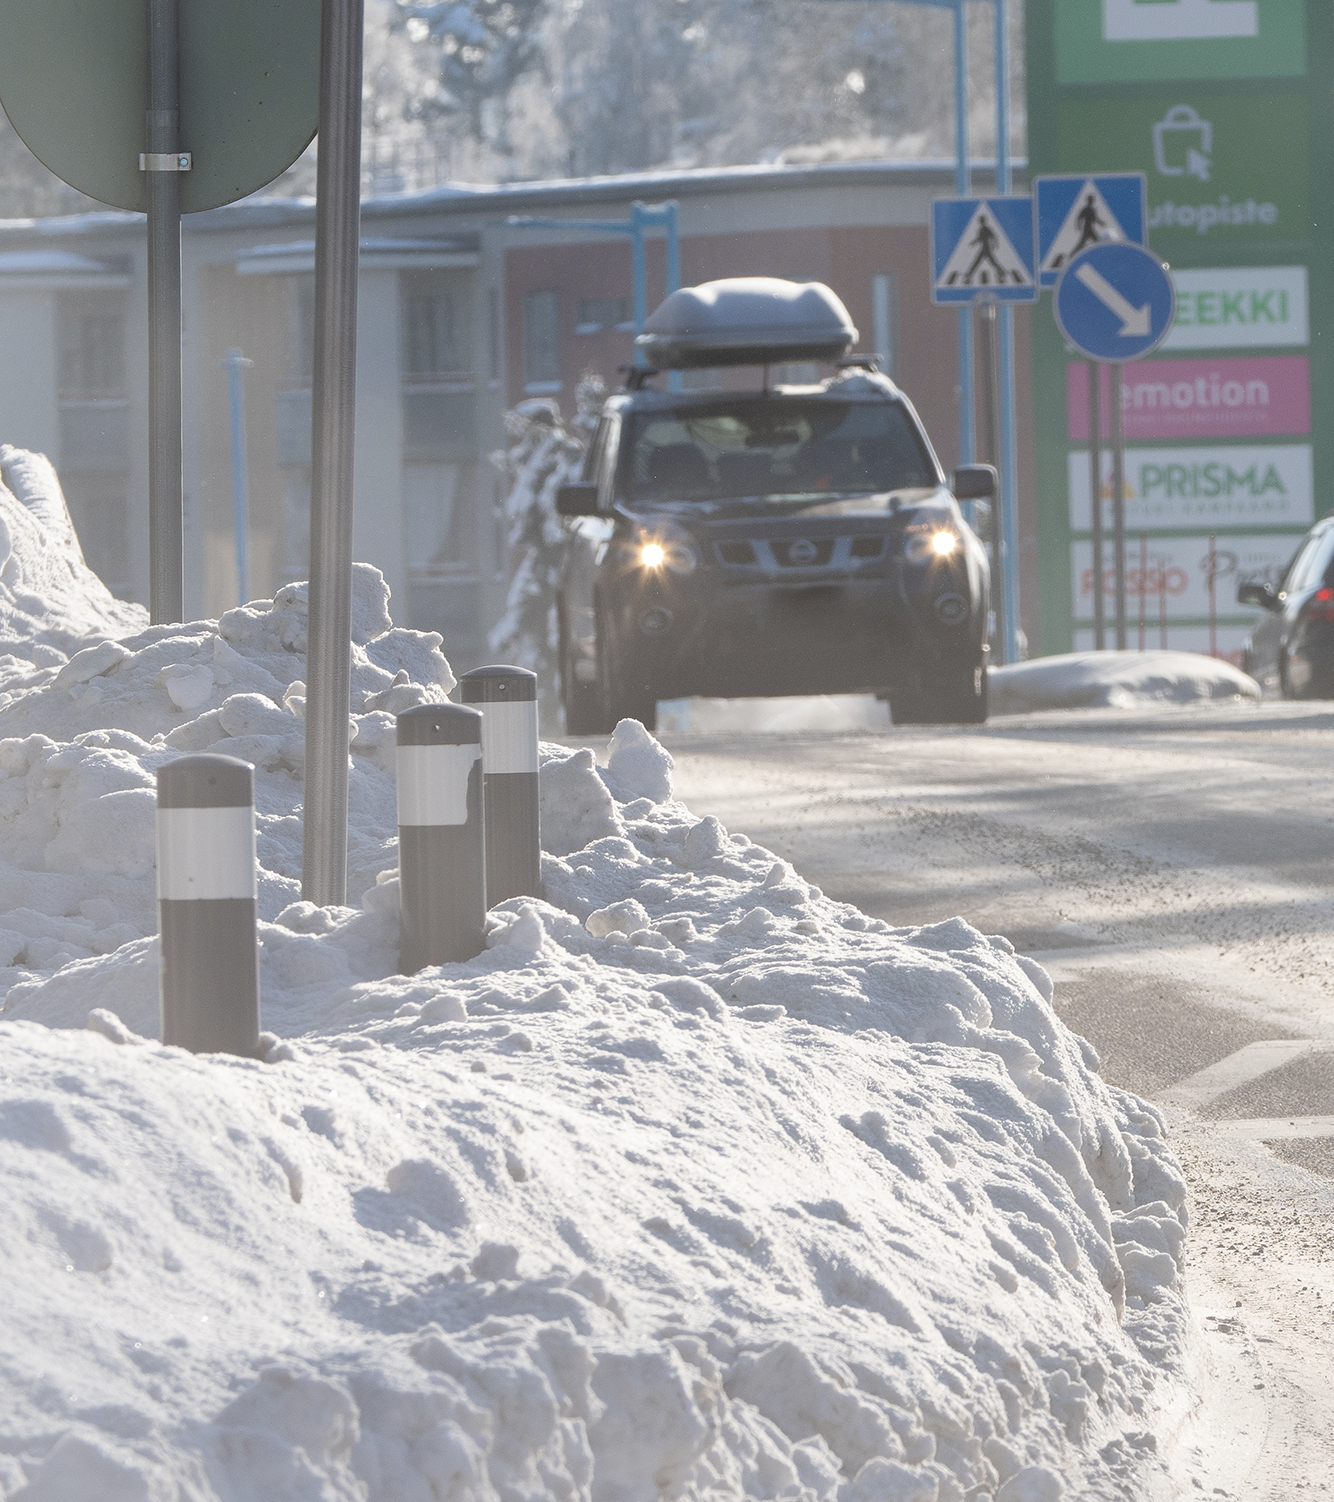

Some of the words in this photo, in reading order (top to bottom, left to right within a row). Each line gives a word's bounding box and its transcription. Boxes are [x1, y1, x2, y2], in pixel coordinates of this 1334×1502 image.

[1149, 196, 1278, 234] utopiste
[1175, 289, 1289, 325] EEKKI
[1139, 461, 1288, 497] PRISMA
